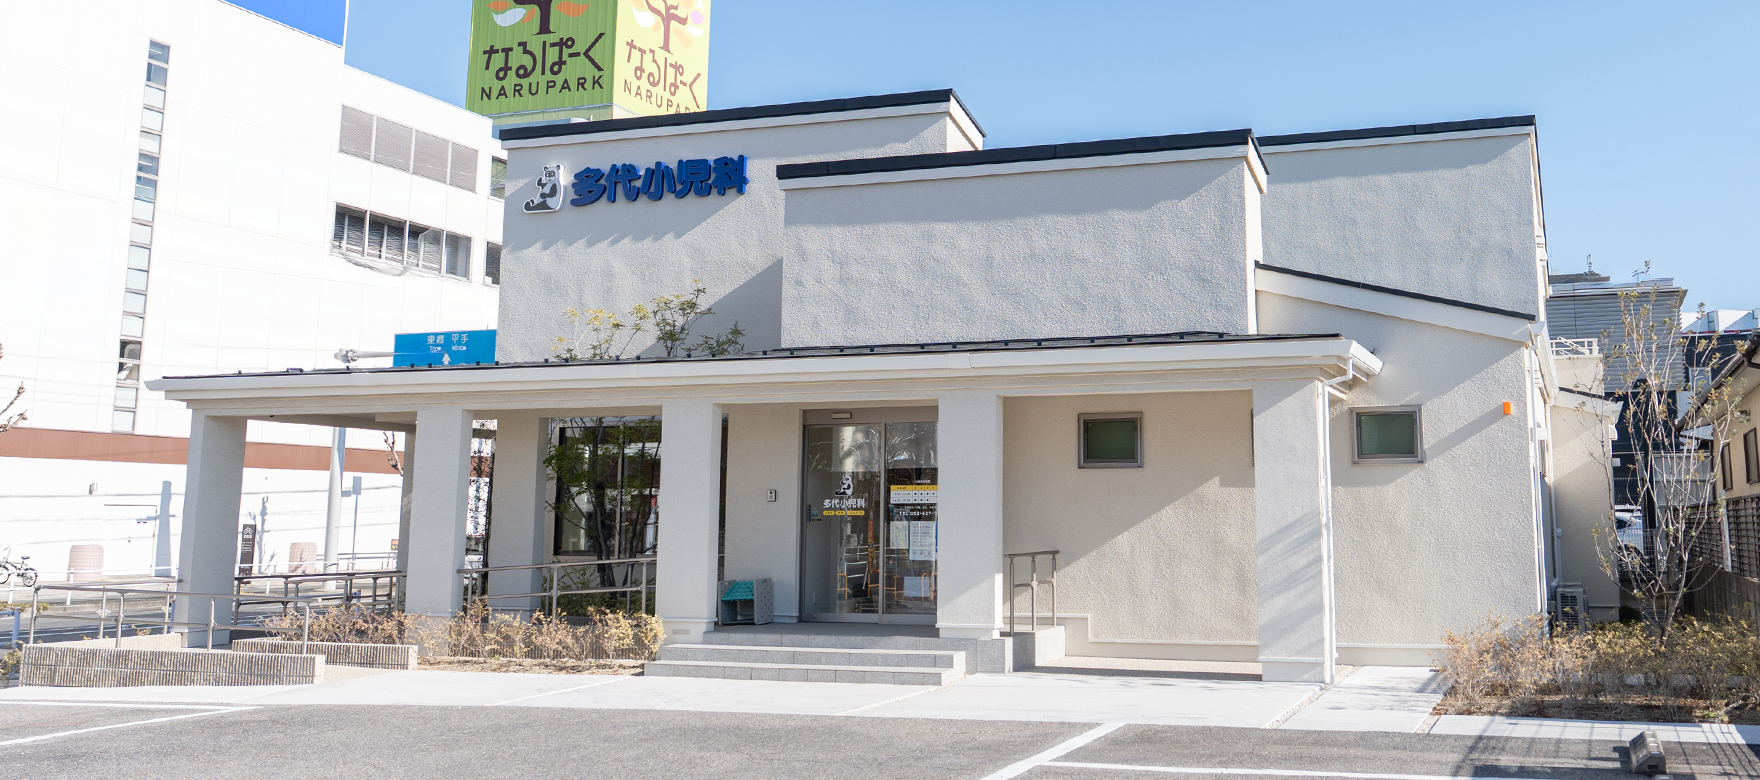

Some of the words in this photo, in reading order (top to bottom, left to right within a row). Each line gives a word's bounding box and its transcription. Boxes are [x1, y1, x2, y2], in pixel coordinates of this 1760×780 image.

[483, 33, 605, 81] なるぱーく
[626, 39, 701, 109] なるぱーく
[480, 75, 604, 101] NARUPARK
[623, 79, 697, 114] NARUPAR
[570, 154, 749, 206] 多代小児科
[426, 334, 445, 345] 東郷
[451, 333, 469, 344] 平手
[823, 498, 865, 508] 多代小児科
